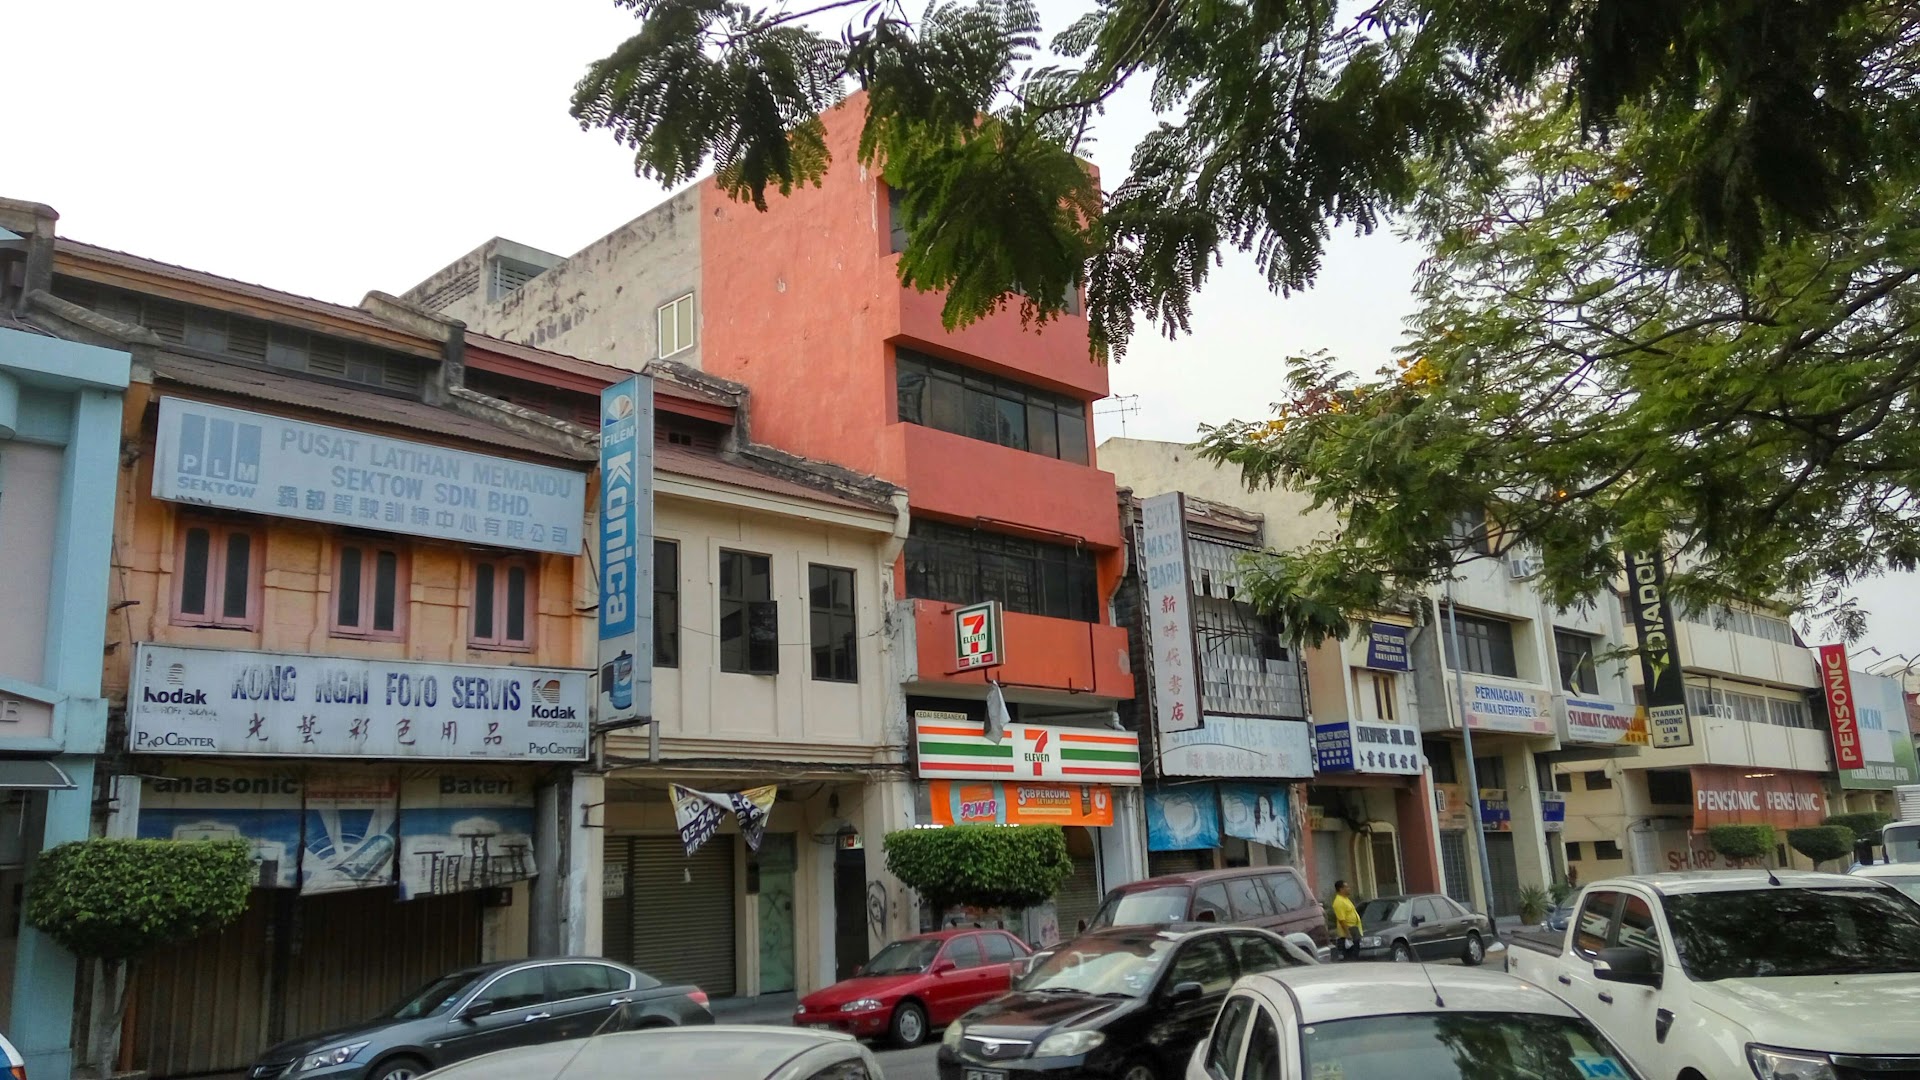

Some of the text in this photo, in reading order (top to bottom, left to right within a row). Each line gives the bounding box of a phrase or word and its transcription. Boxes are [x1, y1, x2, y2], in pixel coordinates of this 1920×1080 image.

[604, 425, 634, 448] FILEM
[280, 427, 571, 499] PUSAT LATIHAN MEMANDU
[177, 476, 256, 499] SEKTOW
[331, 465, 423, 501] SEKTOW
[487, 491, 533, 518] BHD.
[605, 451, 632, 626] Konica
[231, 664, 521, 711] KONG NGAI FOTO SERVIS
[1475, 685, 1524, 704] PERNIAGAAN
[531, 705, 576, 720] Kodak
[1498, 704, 1531, 718] ENTERPRISE
[1651, 708, 1684, 718] SYARIKAT
[1826, 652, 1857, 762] PENSONIC
[1655, 717, 1683, 727] CHOONG
[1662, 726, 1678, 734] LIAN
[147, 774, 299, 795] anasonic
[440, 776, 513, 795] Bateri
[1036, 790, 1071, 799] PERCUMA
[1766, 791, 1821, 812] PENSONIC
[1667, 849, 1717, 871] SHARP
